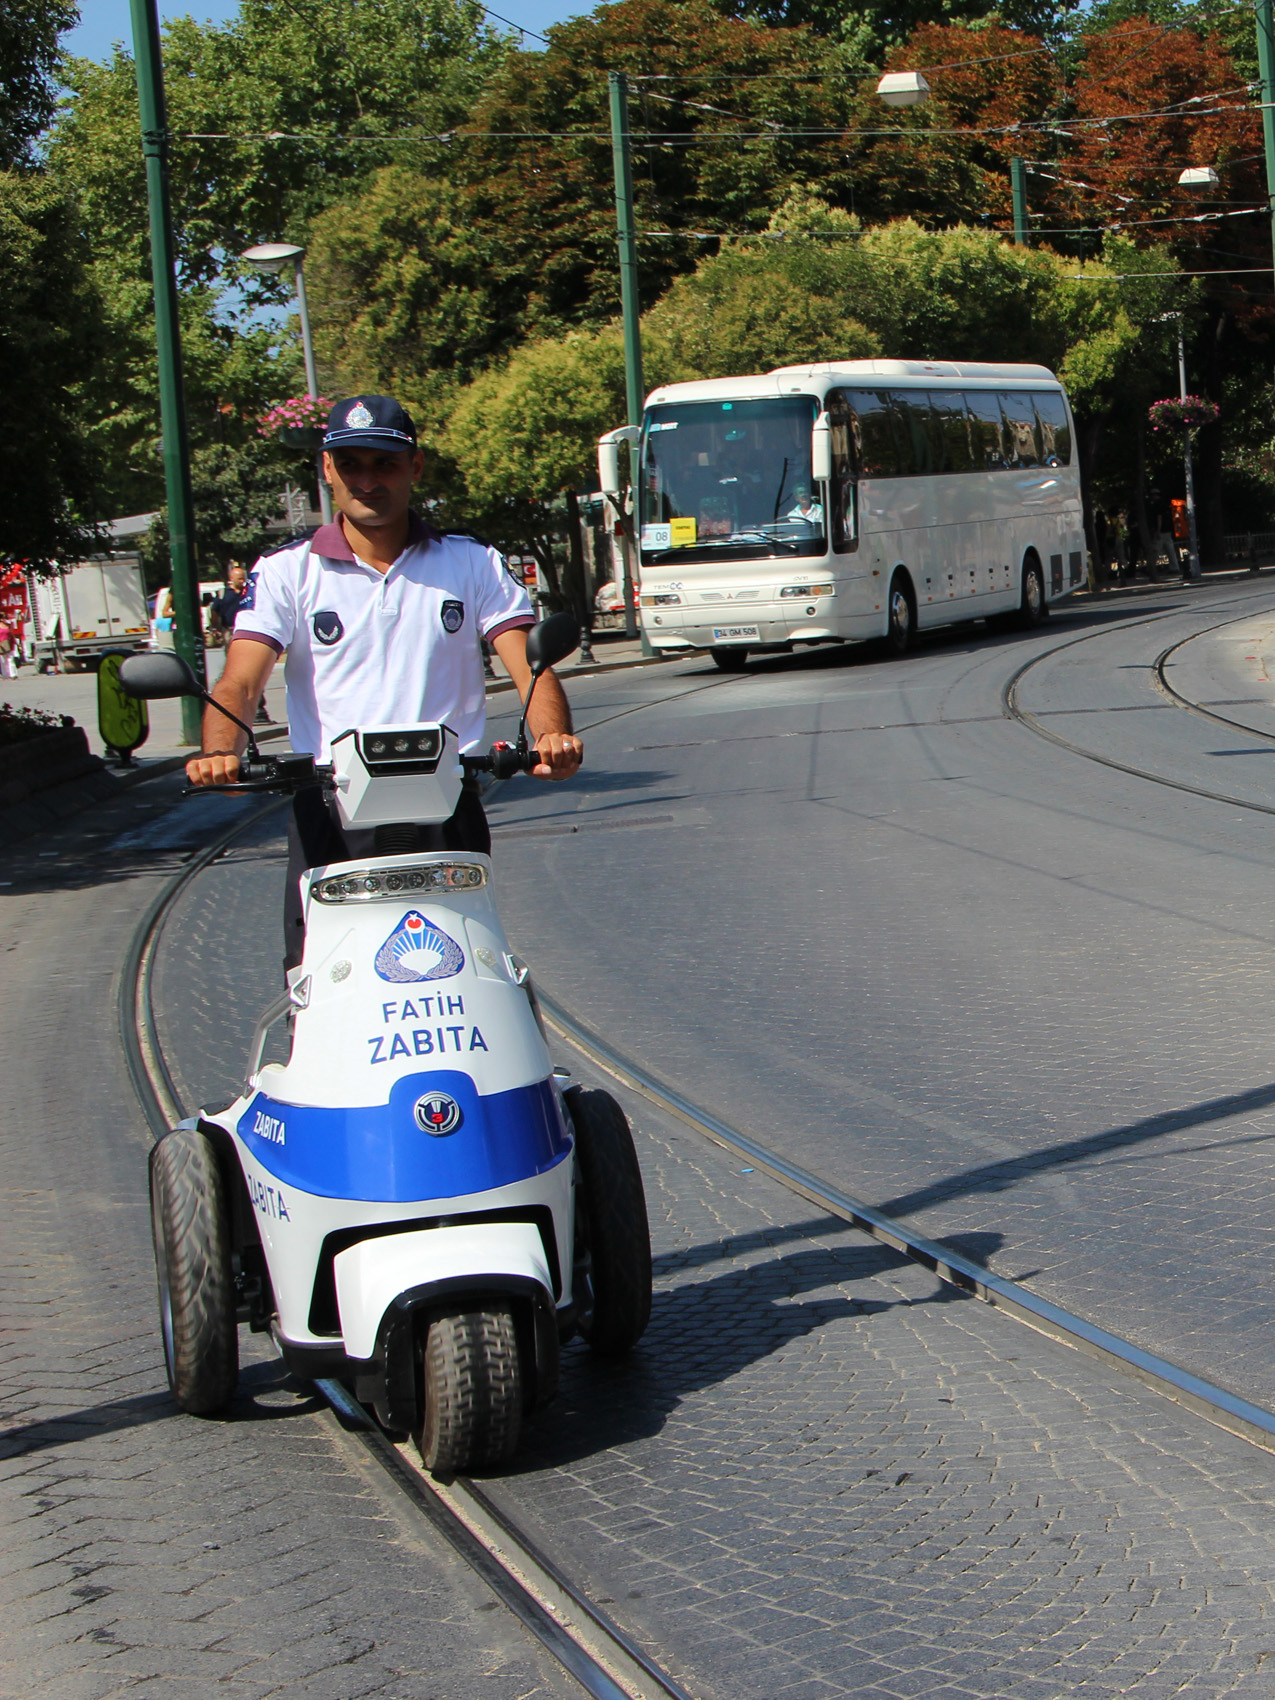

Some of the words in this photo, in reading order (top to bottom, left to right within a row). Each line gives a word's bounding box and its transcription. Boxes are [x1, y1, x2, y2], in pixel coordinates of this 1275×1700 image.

[718, 629, 728, 637] 34
[382, 991, 464, 1023] FATİH
[368, 1026, 489, 1065] ZABITA
[253, 1111, 286, 1146] ZABITA
[247, 1173, 291, 1222] ZABITA
